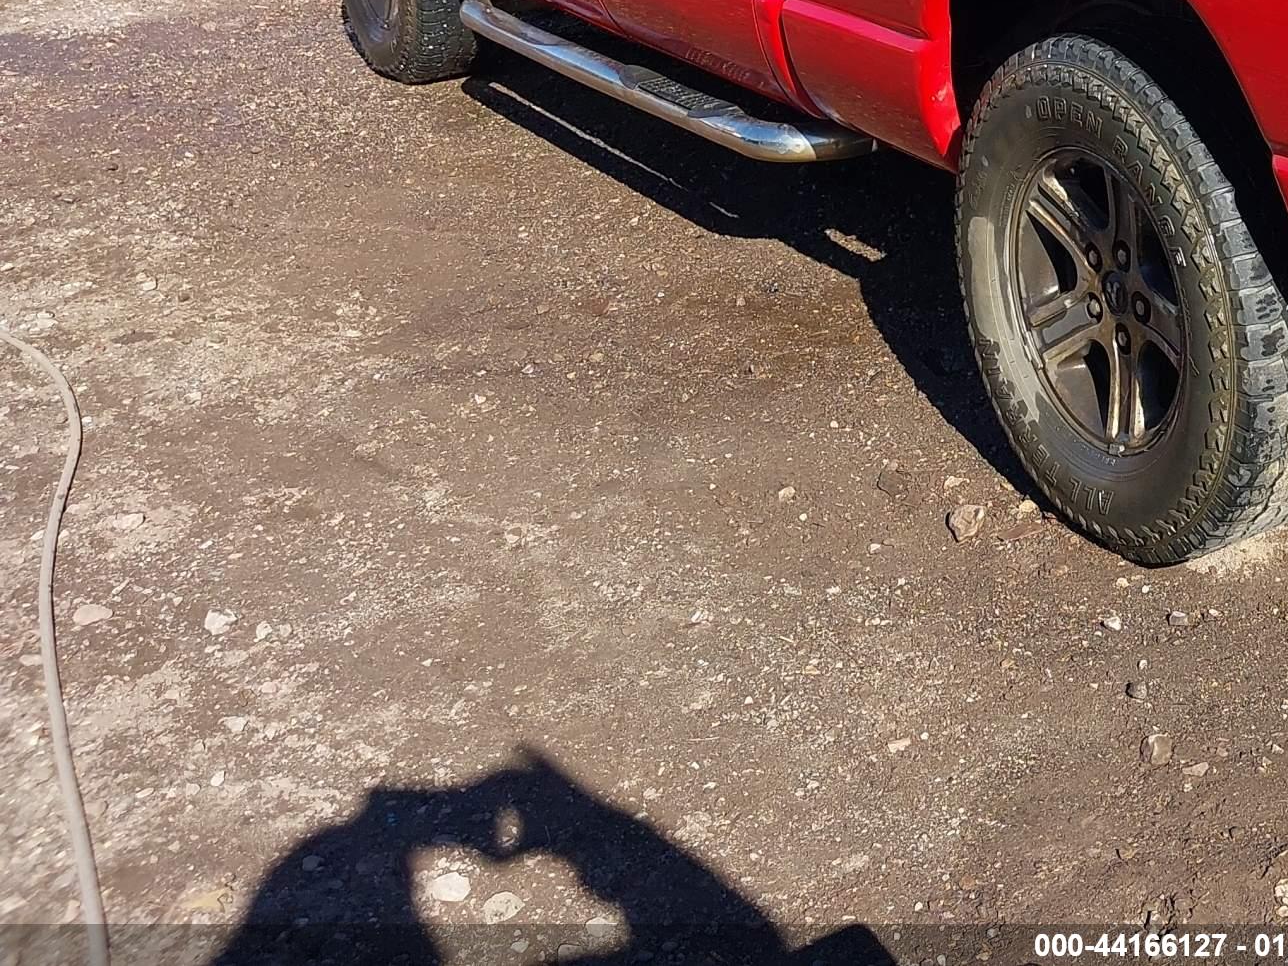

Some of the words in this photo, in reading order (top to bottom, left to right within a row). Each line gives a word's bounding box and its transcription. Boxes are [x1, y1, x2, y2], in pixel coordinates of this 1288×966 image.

[1036, 95, 1103, 138] OPEN
[1112, 135, 1187, 267] RANGE
[975, 337, 1061, 486] TERRAIN
[1069, 475, 1115, 515] ALL
